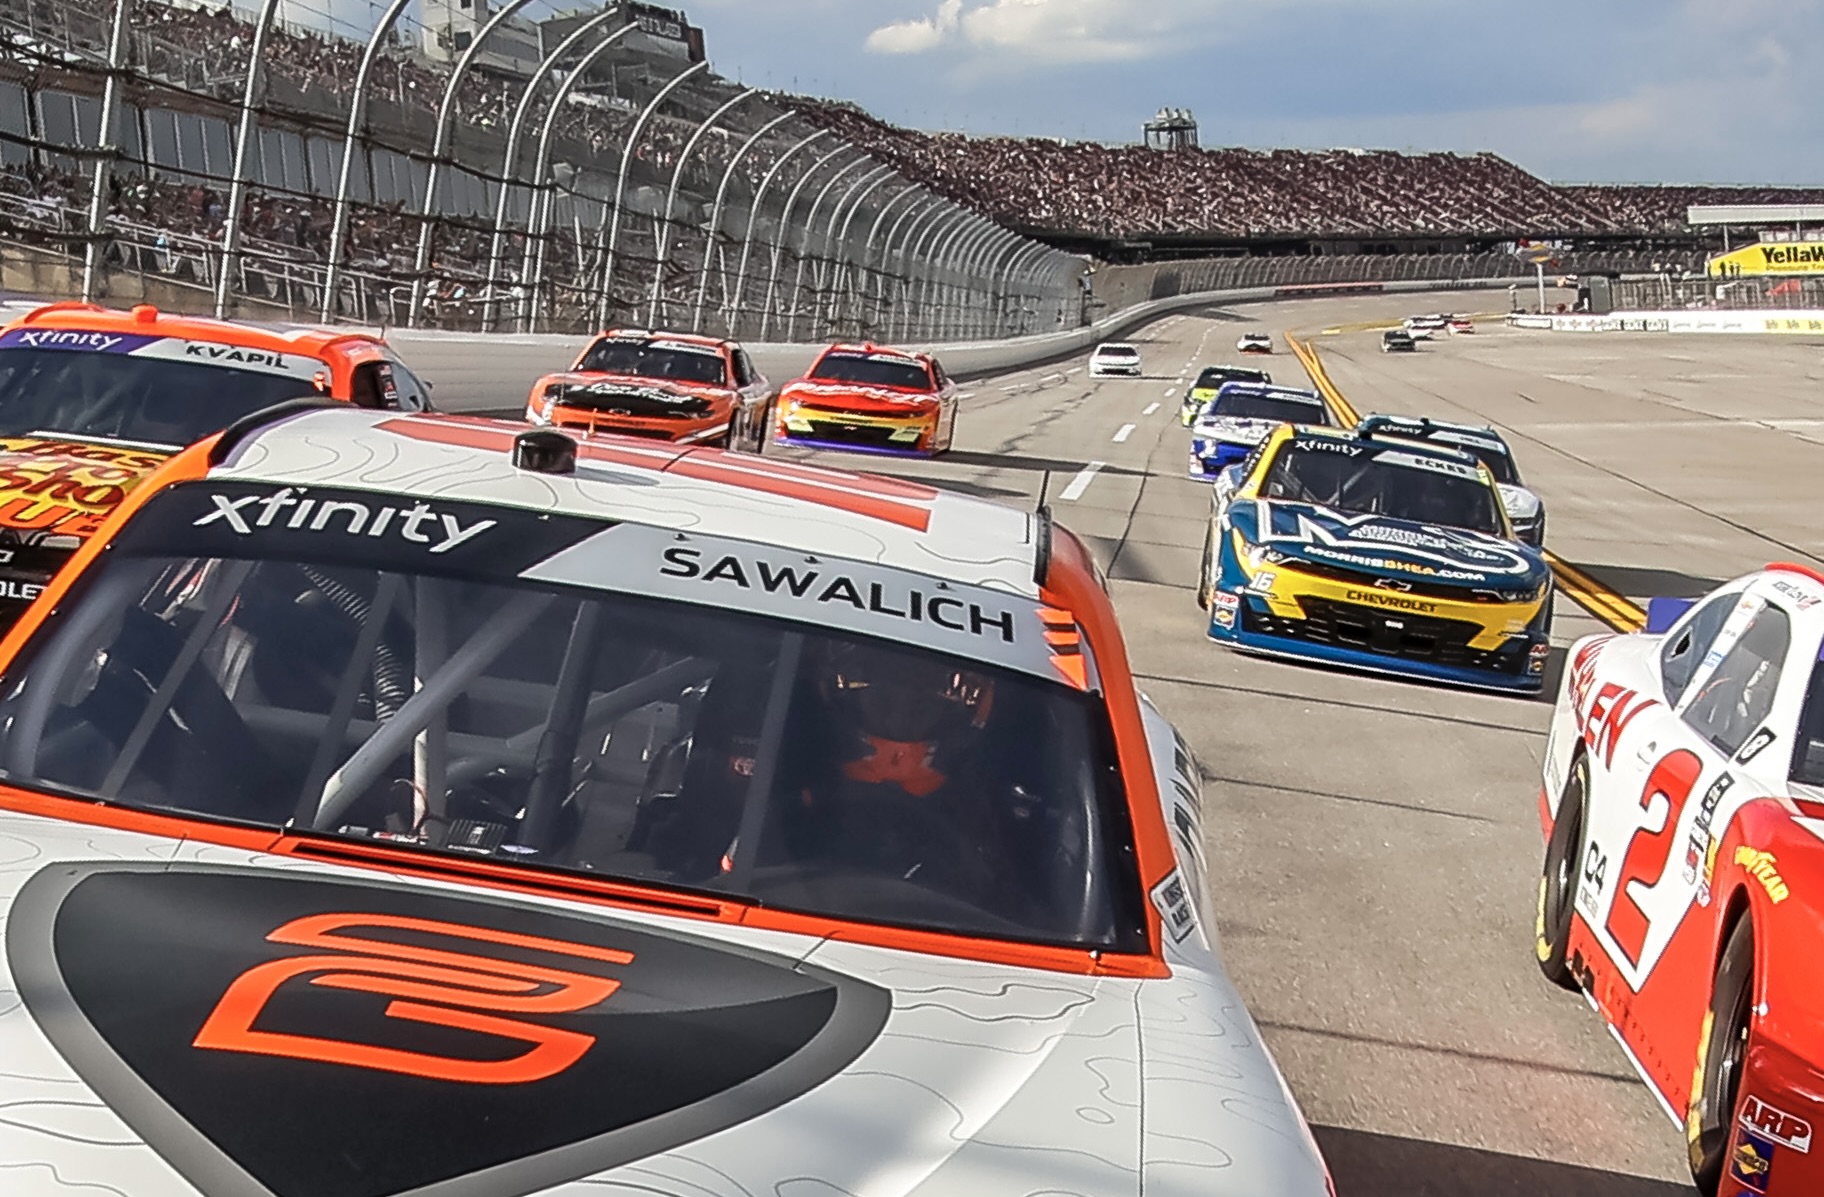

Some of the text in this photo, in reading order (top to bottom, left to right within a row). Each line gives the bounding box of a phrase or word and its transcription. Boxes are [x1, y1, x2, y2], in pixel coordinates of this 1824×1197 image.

[19, 329, 124, 350] xfinity
[186, 344, 289, 371] KVAPIL
[1294, 439, 1364, 458] xfinity
[192, 486, 499, 555] xfinity
[659, 546, 1015, 645] SAWALICH
[1346, 590, 1438, 614] CHEVROLET
[1604, 747, 1704, 972] 2
